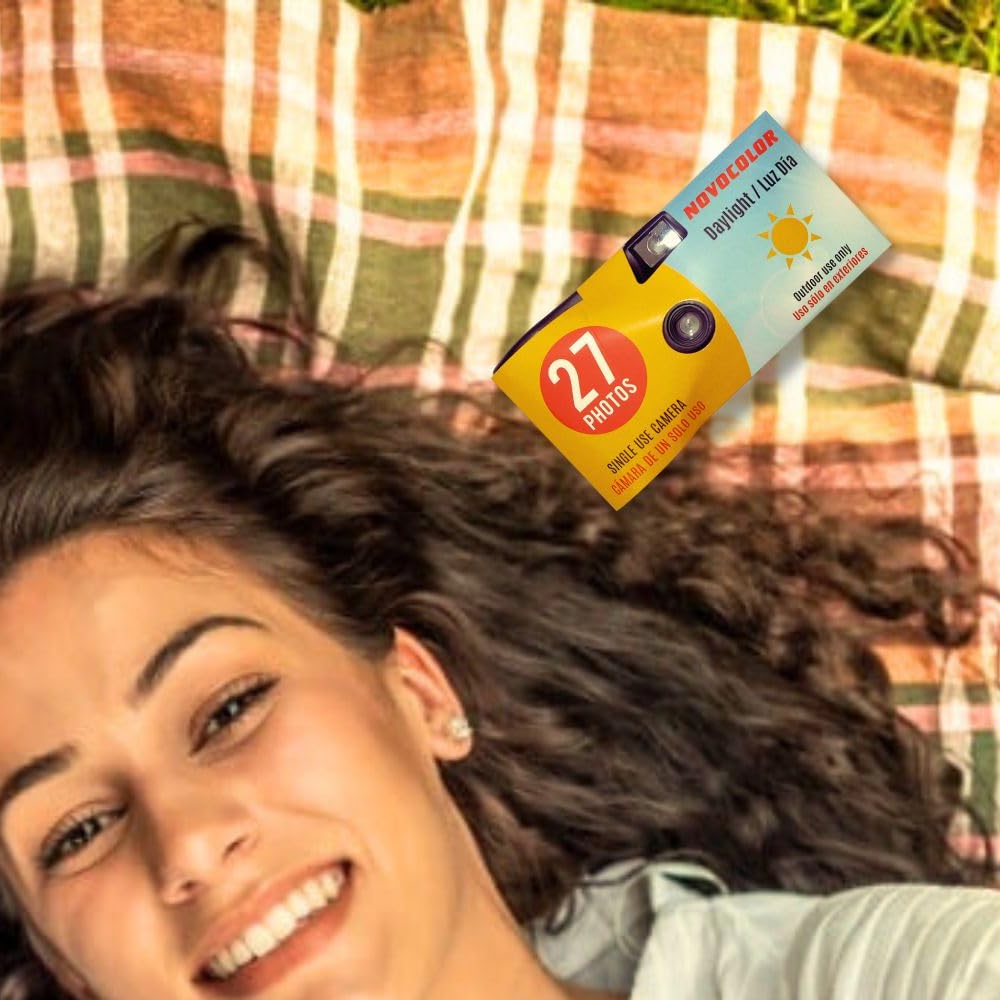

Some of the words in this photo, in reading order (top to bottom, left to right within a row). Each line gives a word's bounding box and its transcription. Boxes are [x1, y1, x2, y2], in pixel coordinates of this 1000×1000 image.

[683, 129, 779, 221] NOVOCOLOR
[703, 192, 756, 241] Daylight
[756, 169, 782, 192] Luz
[774, 155, 799, 176] Día
[792, 304, 809, 321] Uso
[807, 289, 825, 308] sólo
[823, 280, 835, 293] en
[832, 247, 869, 284] exteriores
[793, 271, 824, 302] Outdoor
[821, 258, 837, 275] use
[834, 243, 852, 263] only
[548, 331, 616, 413] 27
[582, 377, 637, 431] PHOTOS
[607, 444, 638, 474] SINGLE
[633, 430, 654, 450] USE
[650, 399, 687, 434] CAMERA
[611, 463, 647, 496] CÁMARA
[643, 451, 659, 467] DE
[654, 438, 672, 455] UN
[667, 418, 690, 442] SOLO
[687, 400, 706, 421] USO
